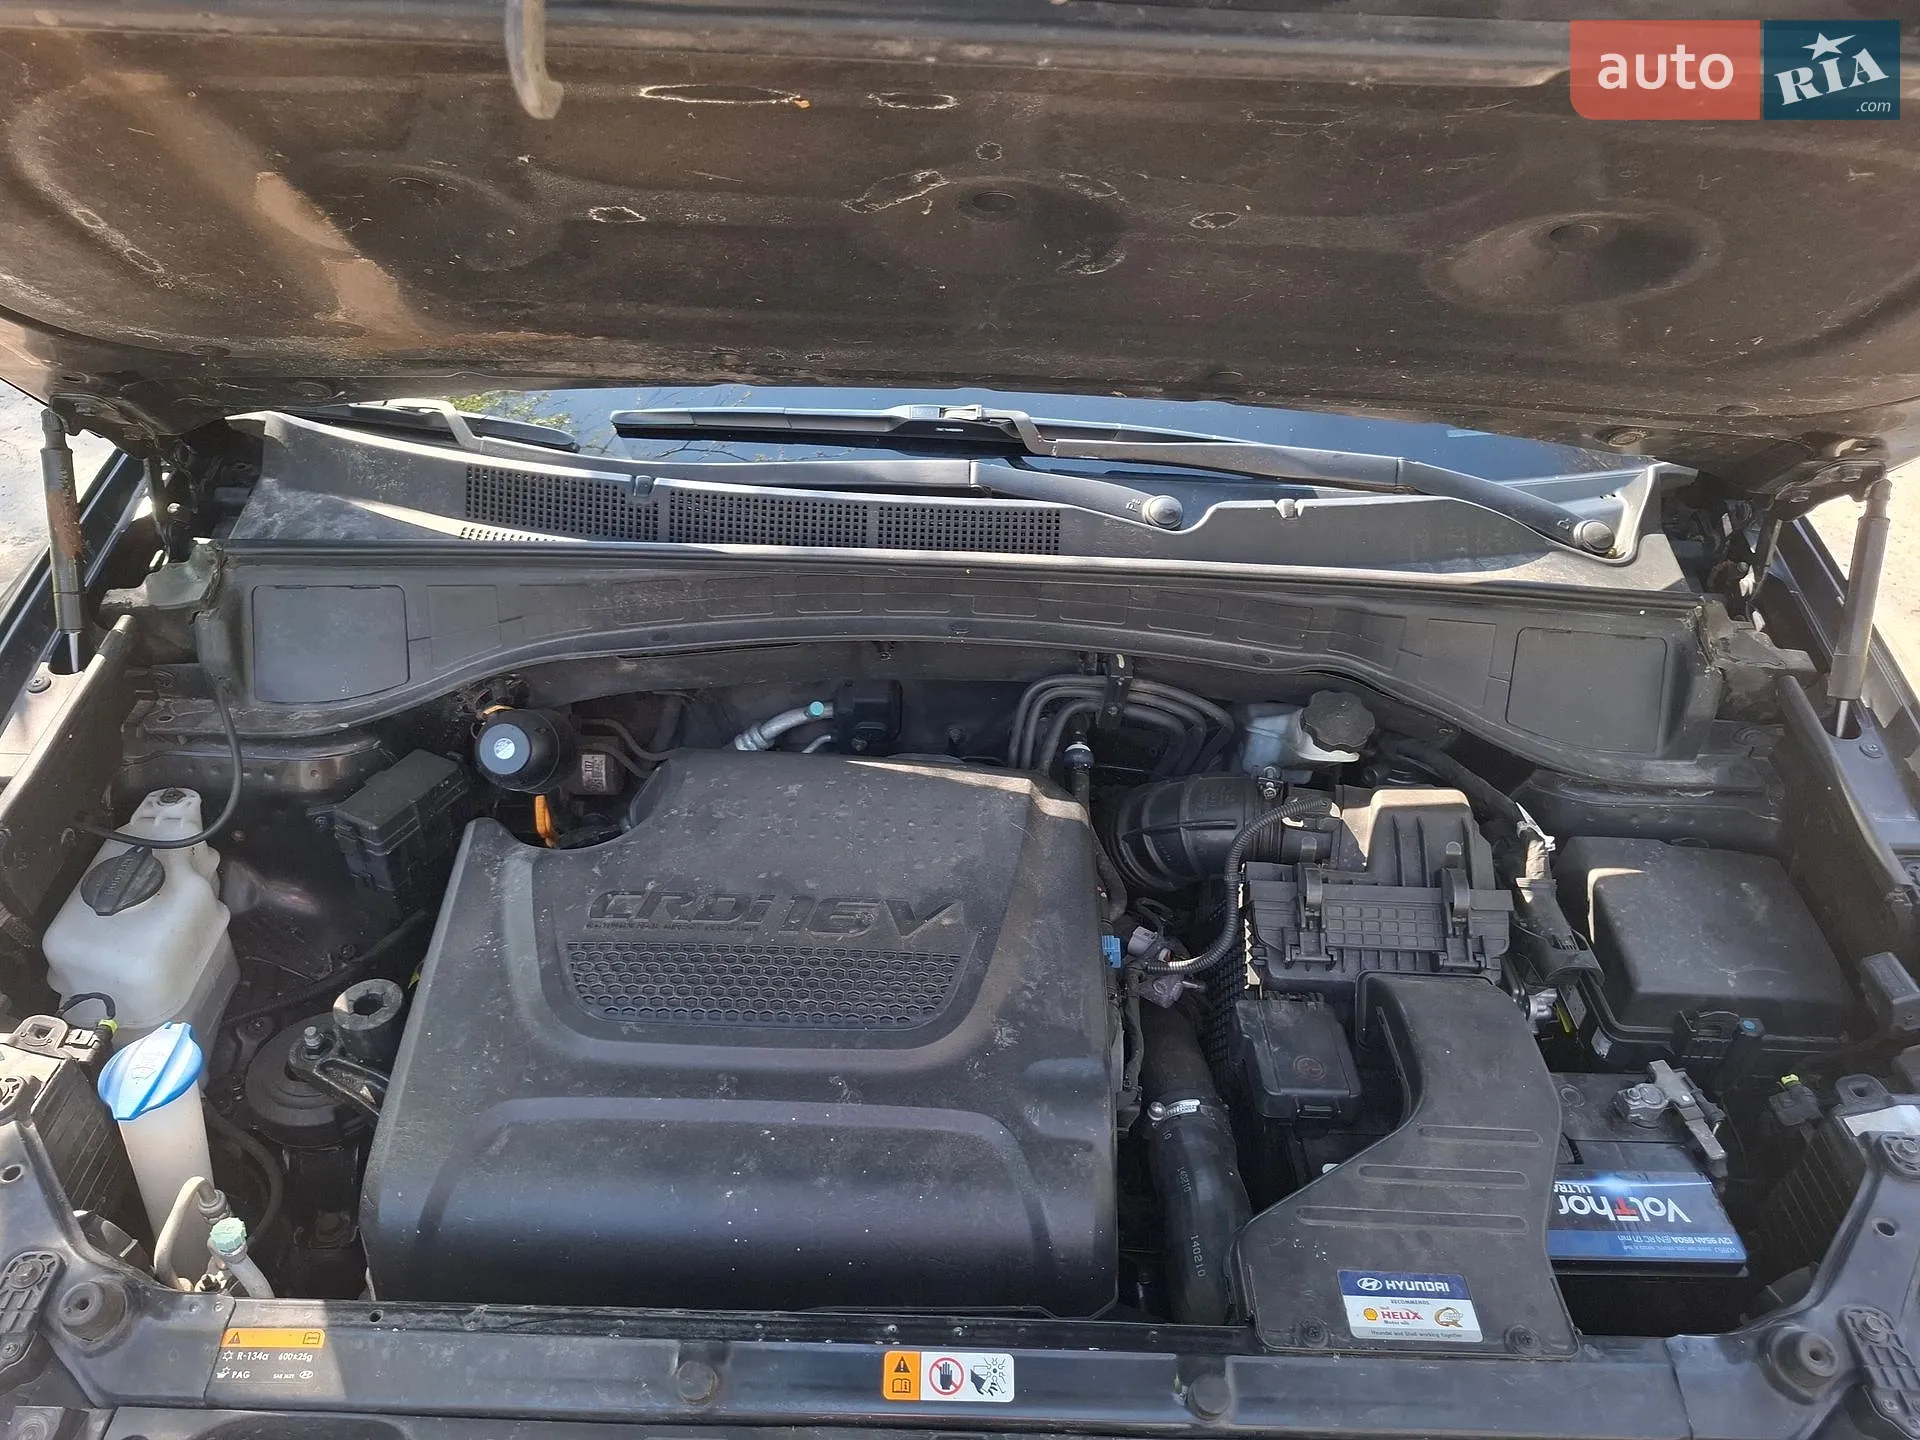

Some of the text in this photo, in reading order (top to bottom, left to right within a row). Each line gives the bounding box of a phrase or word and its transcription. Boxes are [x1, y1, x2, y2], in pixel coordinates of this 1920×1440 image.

[1558, 1194, 1692, 1223] VolThor
[1190, 1233, 1207, 1278] 140210
[1385, 1280, 1450, 1292] HYUNDAI
[1381, 1311, 1422, 1321] HELIX
[236, 1351, 270, 1361] R-134a
[231, 1370, 251, 1379] PAG
